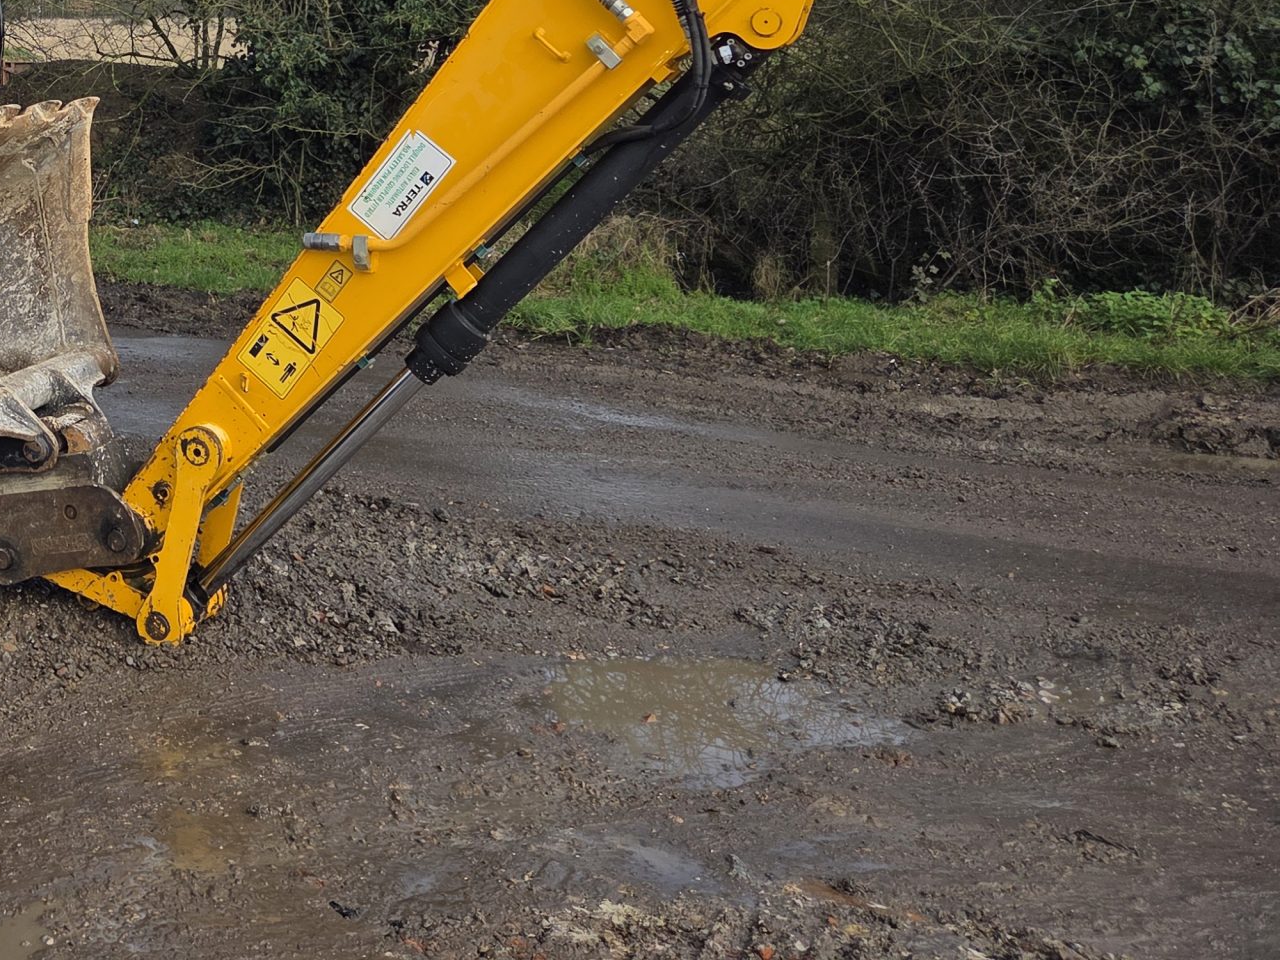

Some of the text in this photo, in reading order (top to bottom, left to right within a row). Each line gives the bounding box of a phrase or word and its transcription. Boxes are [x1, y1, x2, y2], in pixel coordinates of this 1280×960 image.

[363, 144, 411, 203] NO SAFETY PIN REQUIRED
[365, 143, 426, 218] DOUBLE LOCKING COUPLER FITTED
[385, 166, 419, 208] FULLY AUTOMATIC
[392, 184, 423, 216] TEFRA
